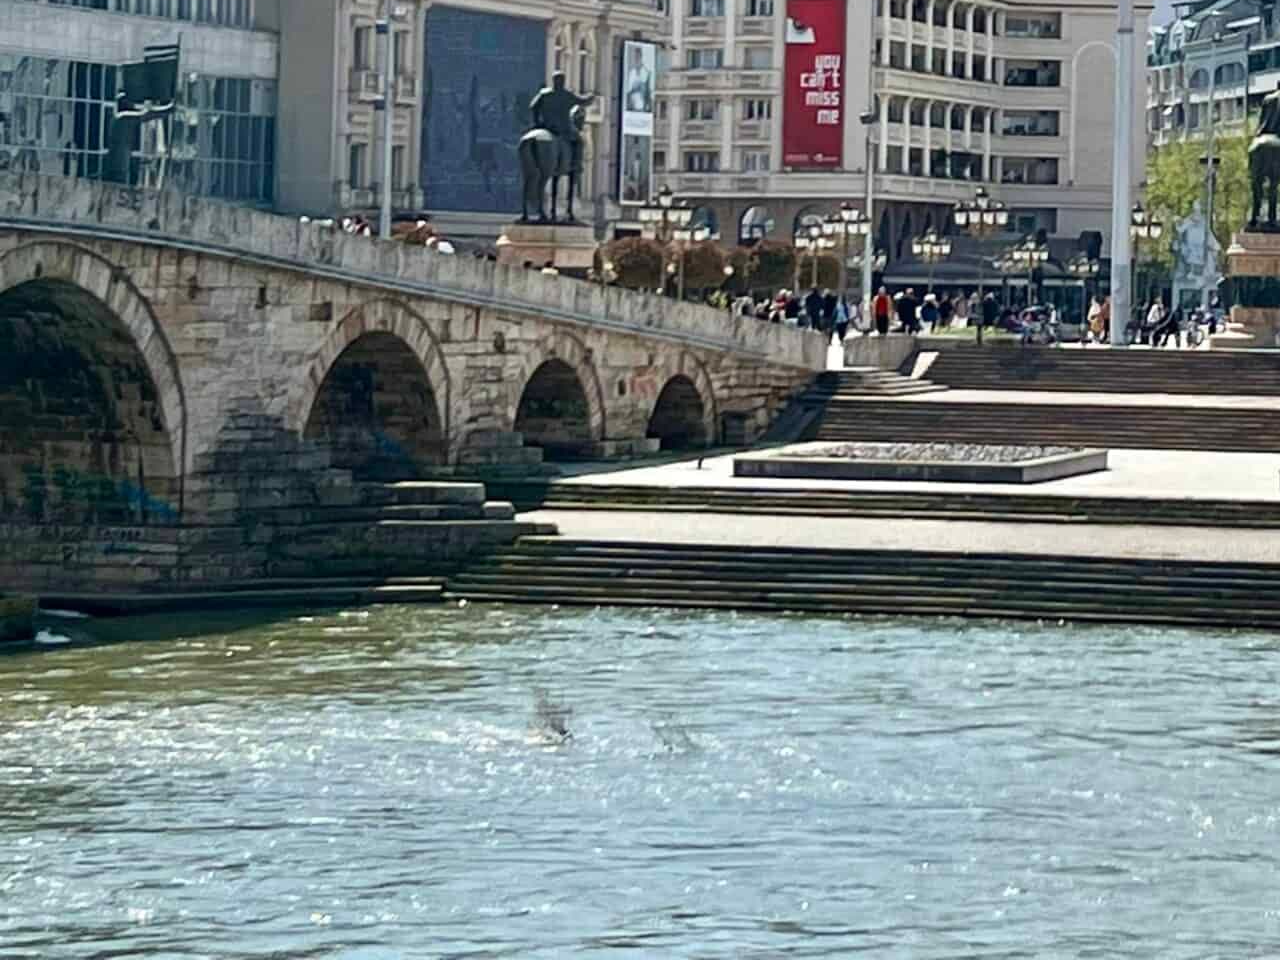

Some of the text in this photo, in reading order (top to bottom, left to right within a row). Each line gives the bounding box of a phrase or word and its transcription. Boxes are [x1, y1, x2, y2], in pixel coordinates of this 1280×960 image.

[815, 54, 841, 72] you
[800, 71, 840, 88] can't
[805, 91, 840, 107] miss
[816, 109, 840, 124] me
